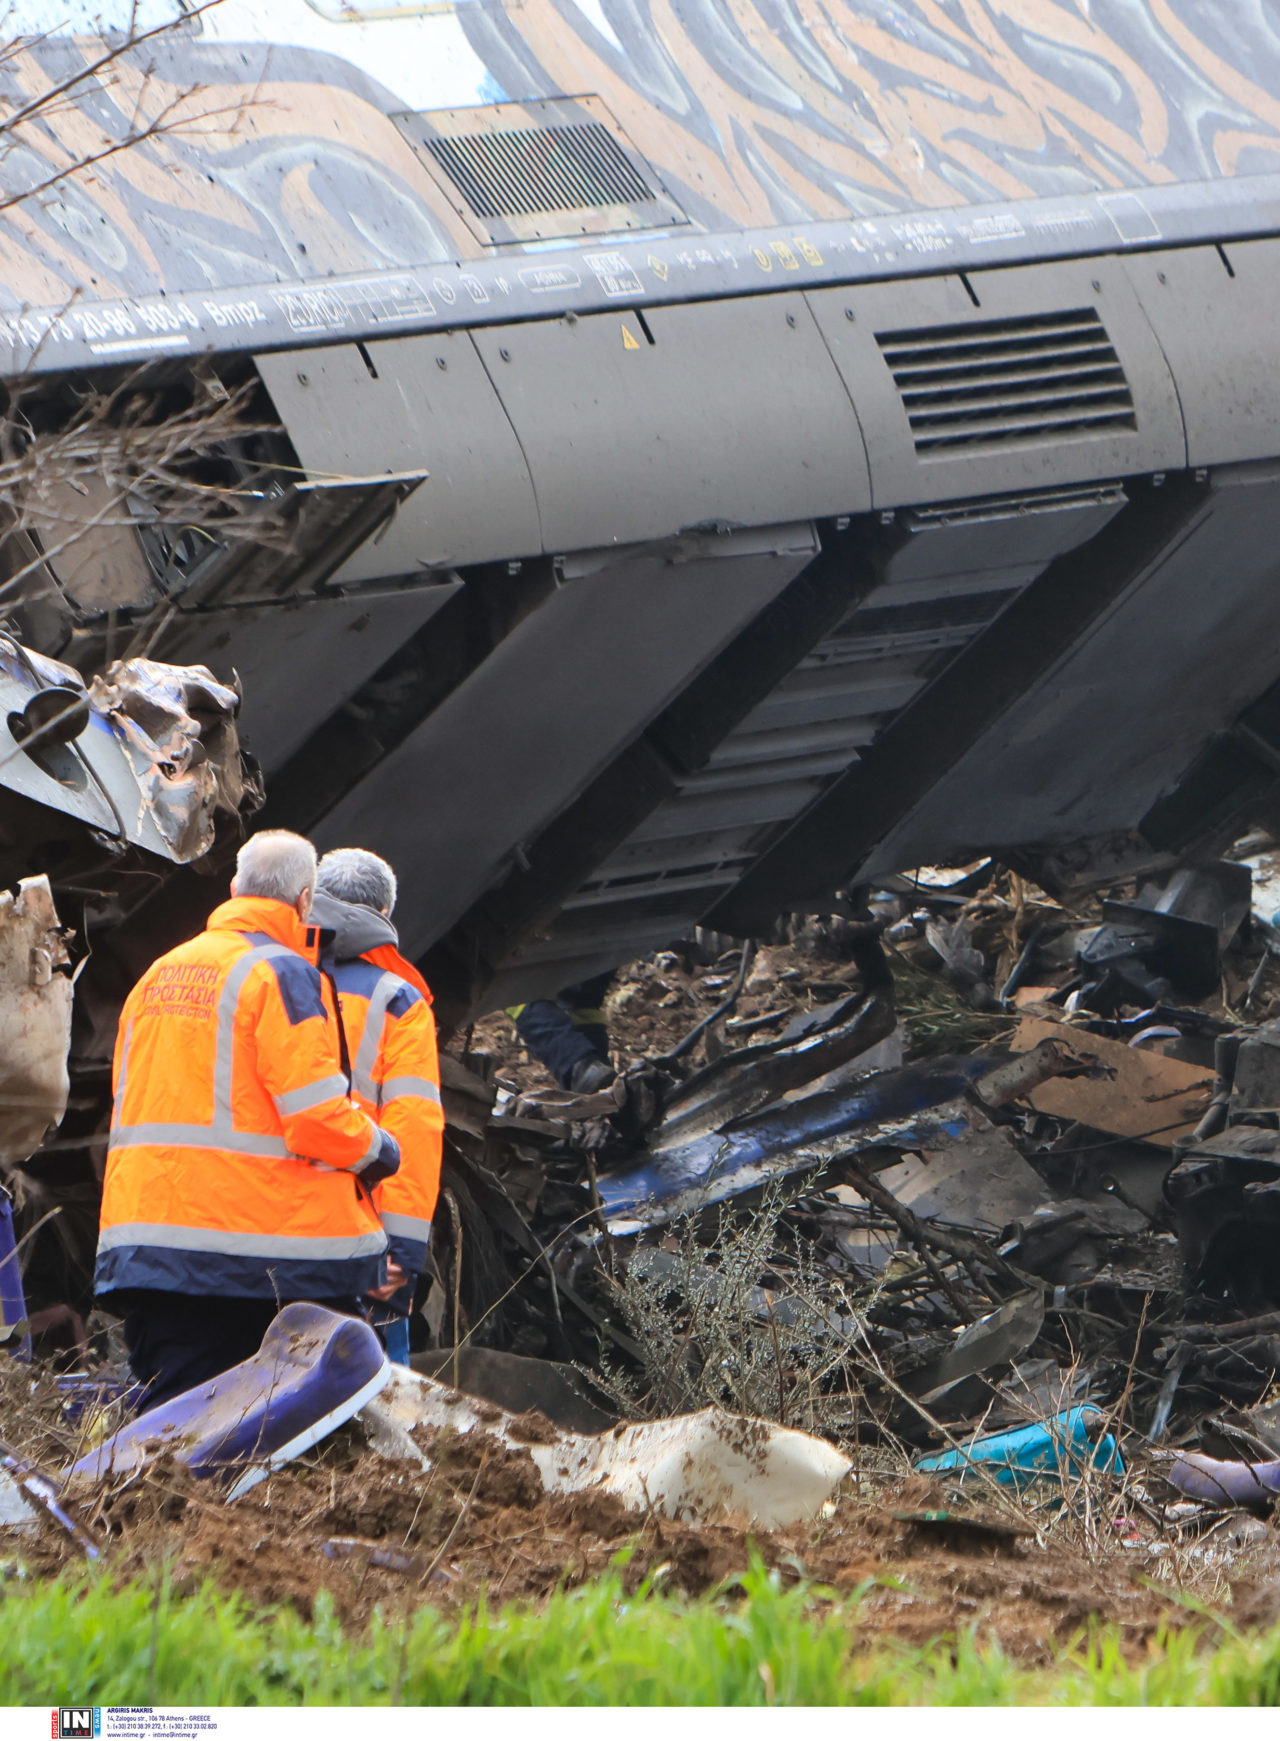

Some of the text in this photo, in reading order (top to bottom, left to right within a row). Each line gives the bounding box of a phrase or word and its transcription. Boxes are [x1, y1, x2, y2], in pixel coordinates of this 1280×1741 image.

[135, 301, 201, 333] 503-8
[202, 299, 268, 329] Bmpz
[156, 964, 220, 985] ΠΟΛΙΤΙΚΗ
[143, 985, 216, 1007] ΠΡΟΣΤΑΣΙΑ
